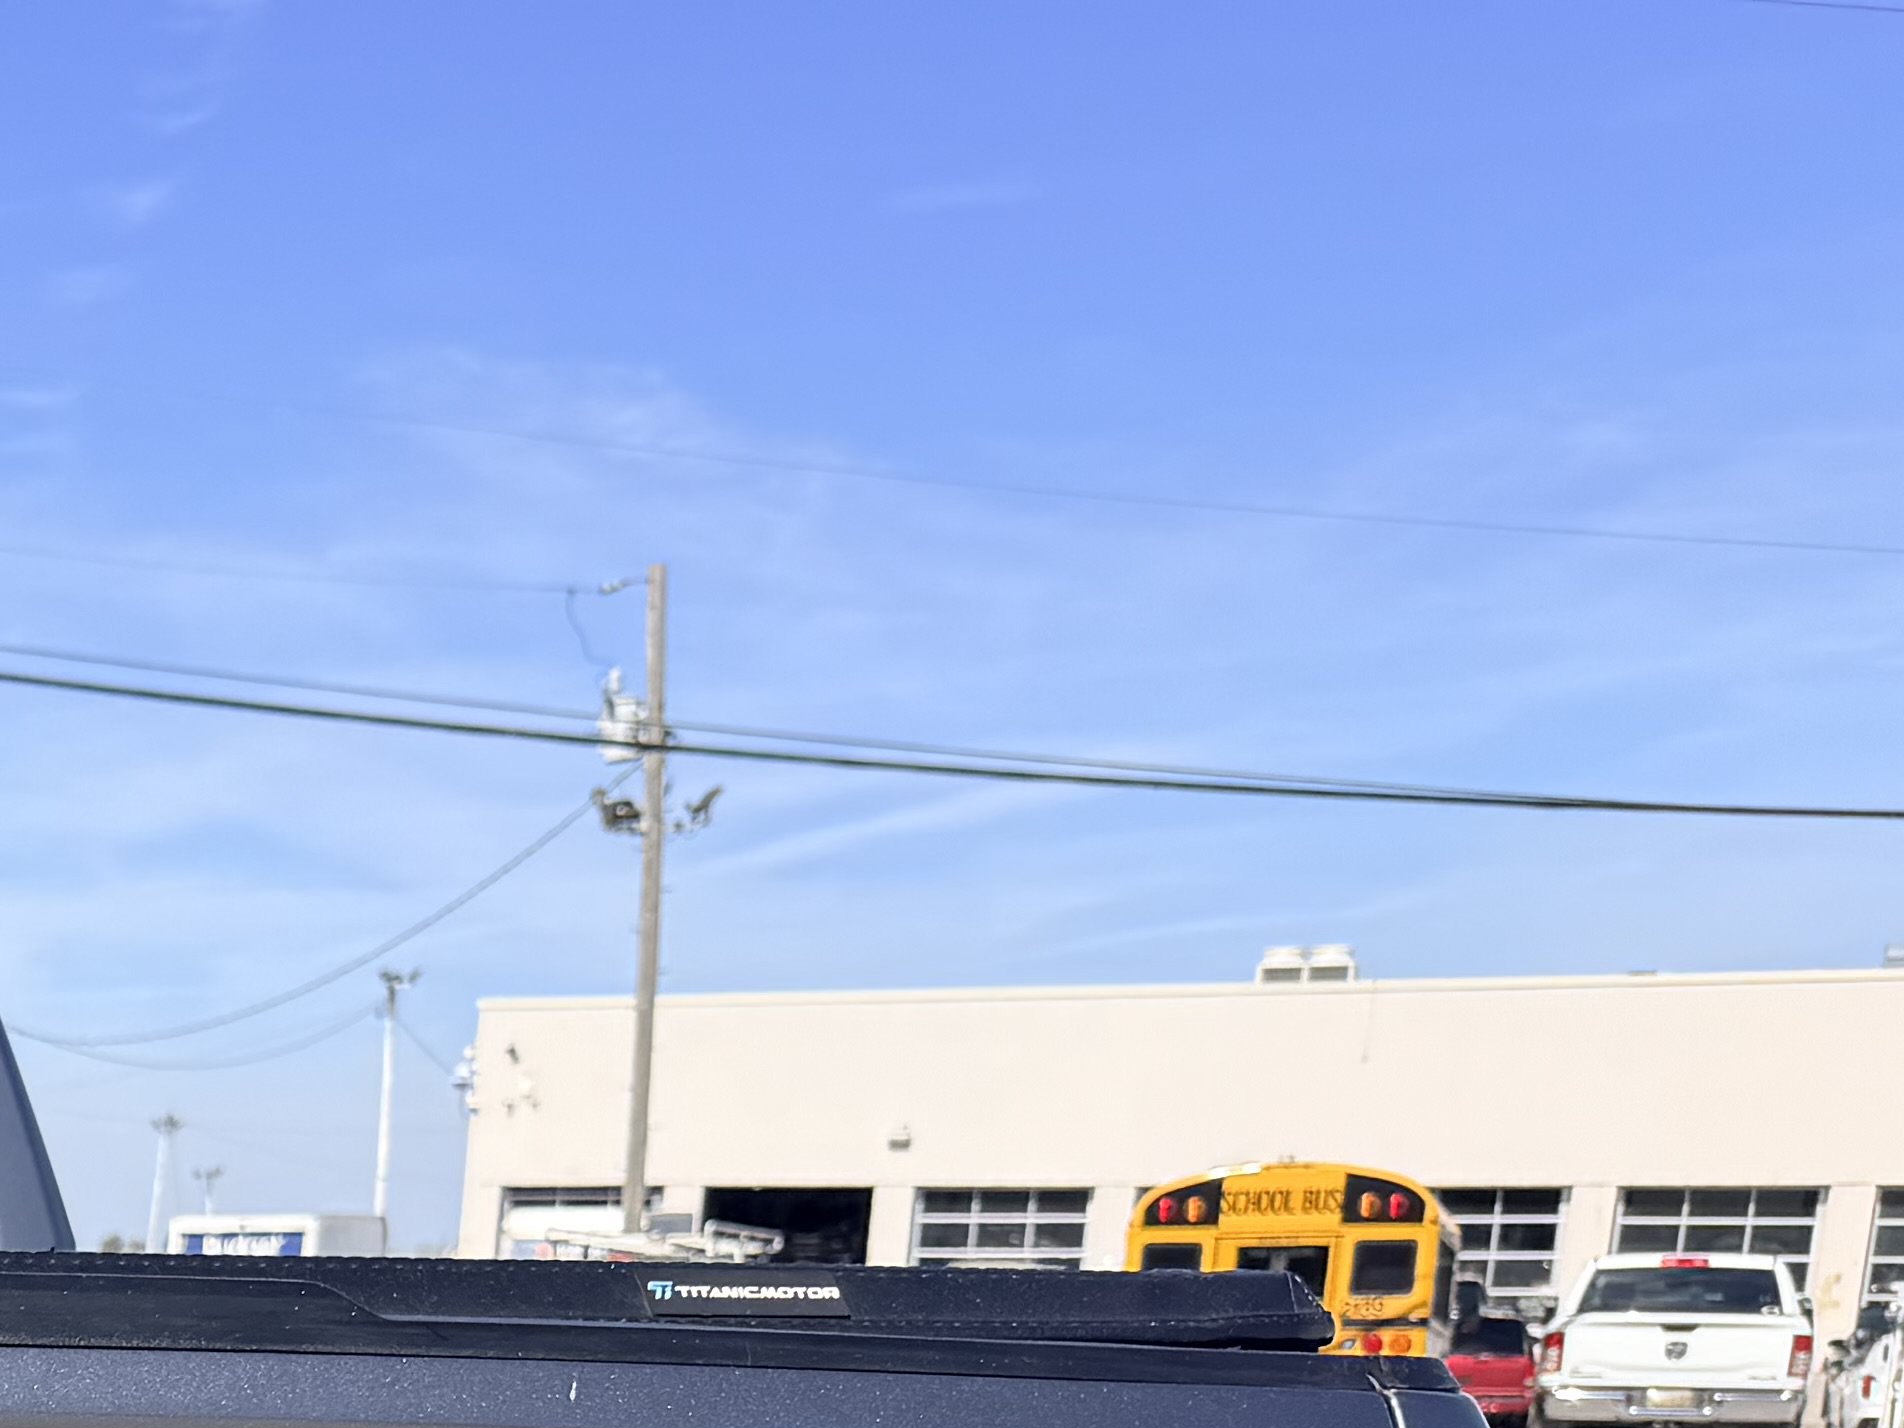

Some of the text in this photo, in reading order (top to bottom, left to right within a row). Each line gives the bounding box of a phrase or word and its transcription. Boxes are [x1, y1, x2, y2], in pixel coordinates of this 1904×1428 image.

[1220, 1188, 1343, 1216] SCHOOL BUS
[674, 1285, 840, 1300] TITANICMOTOR
